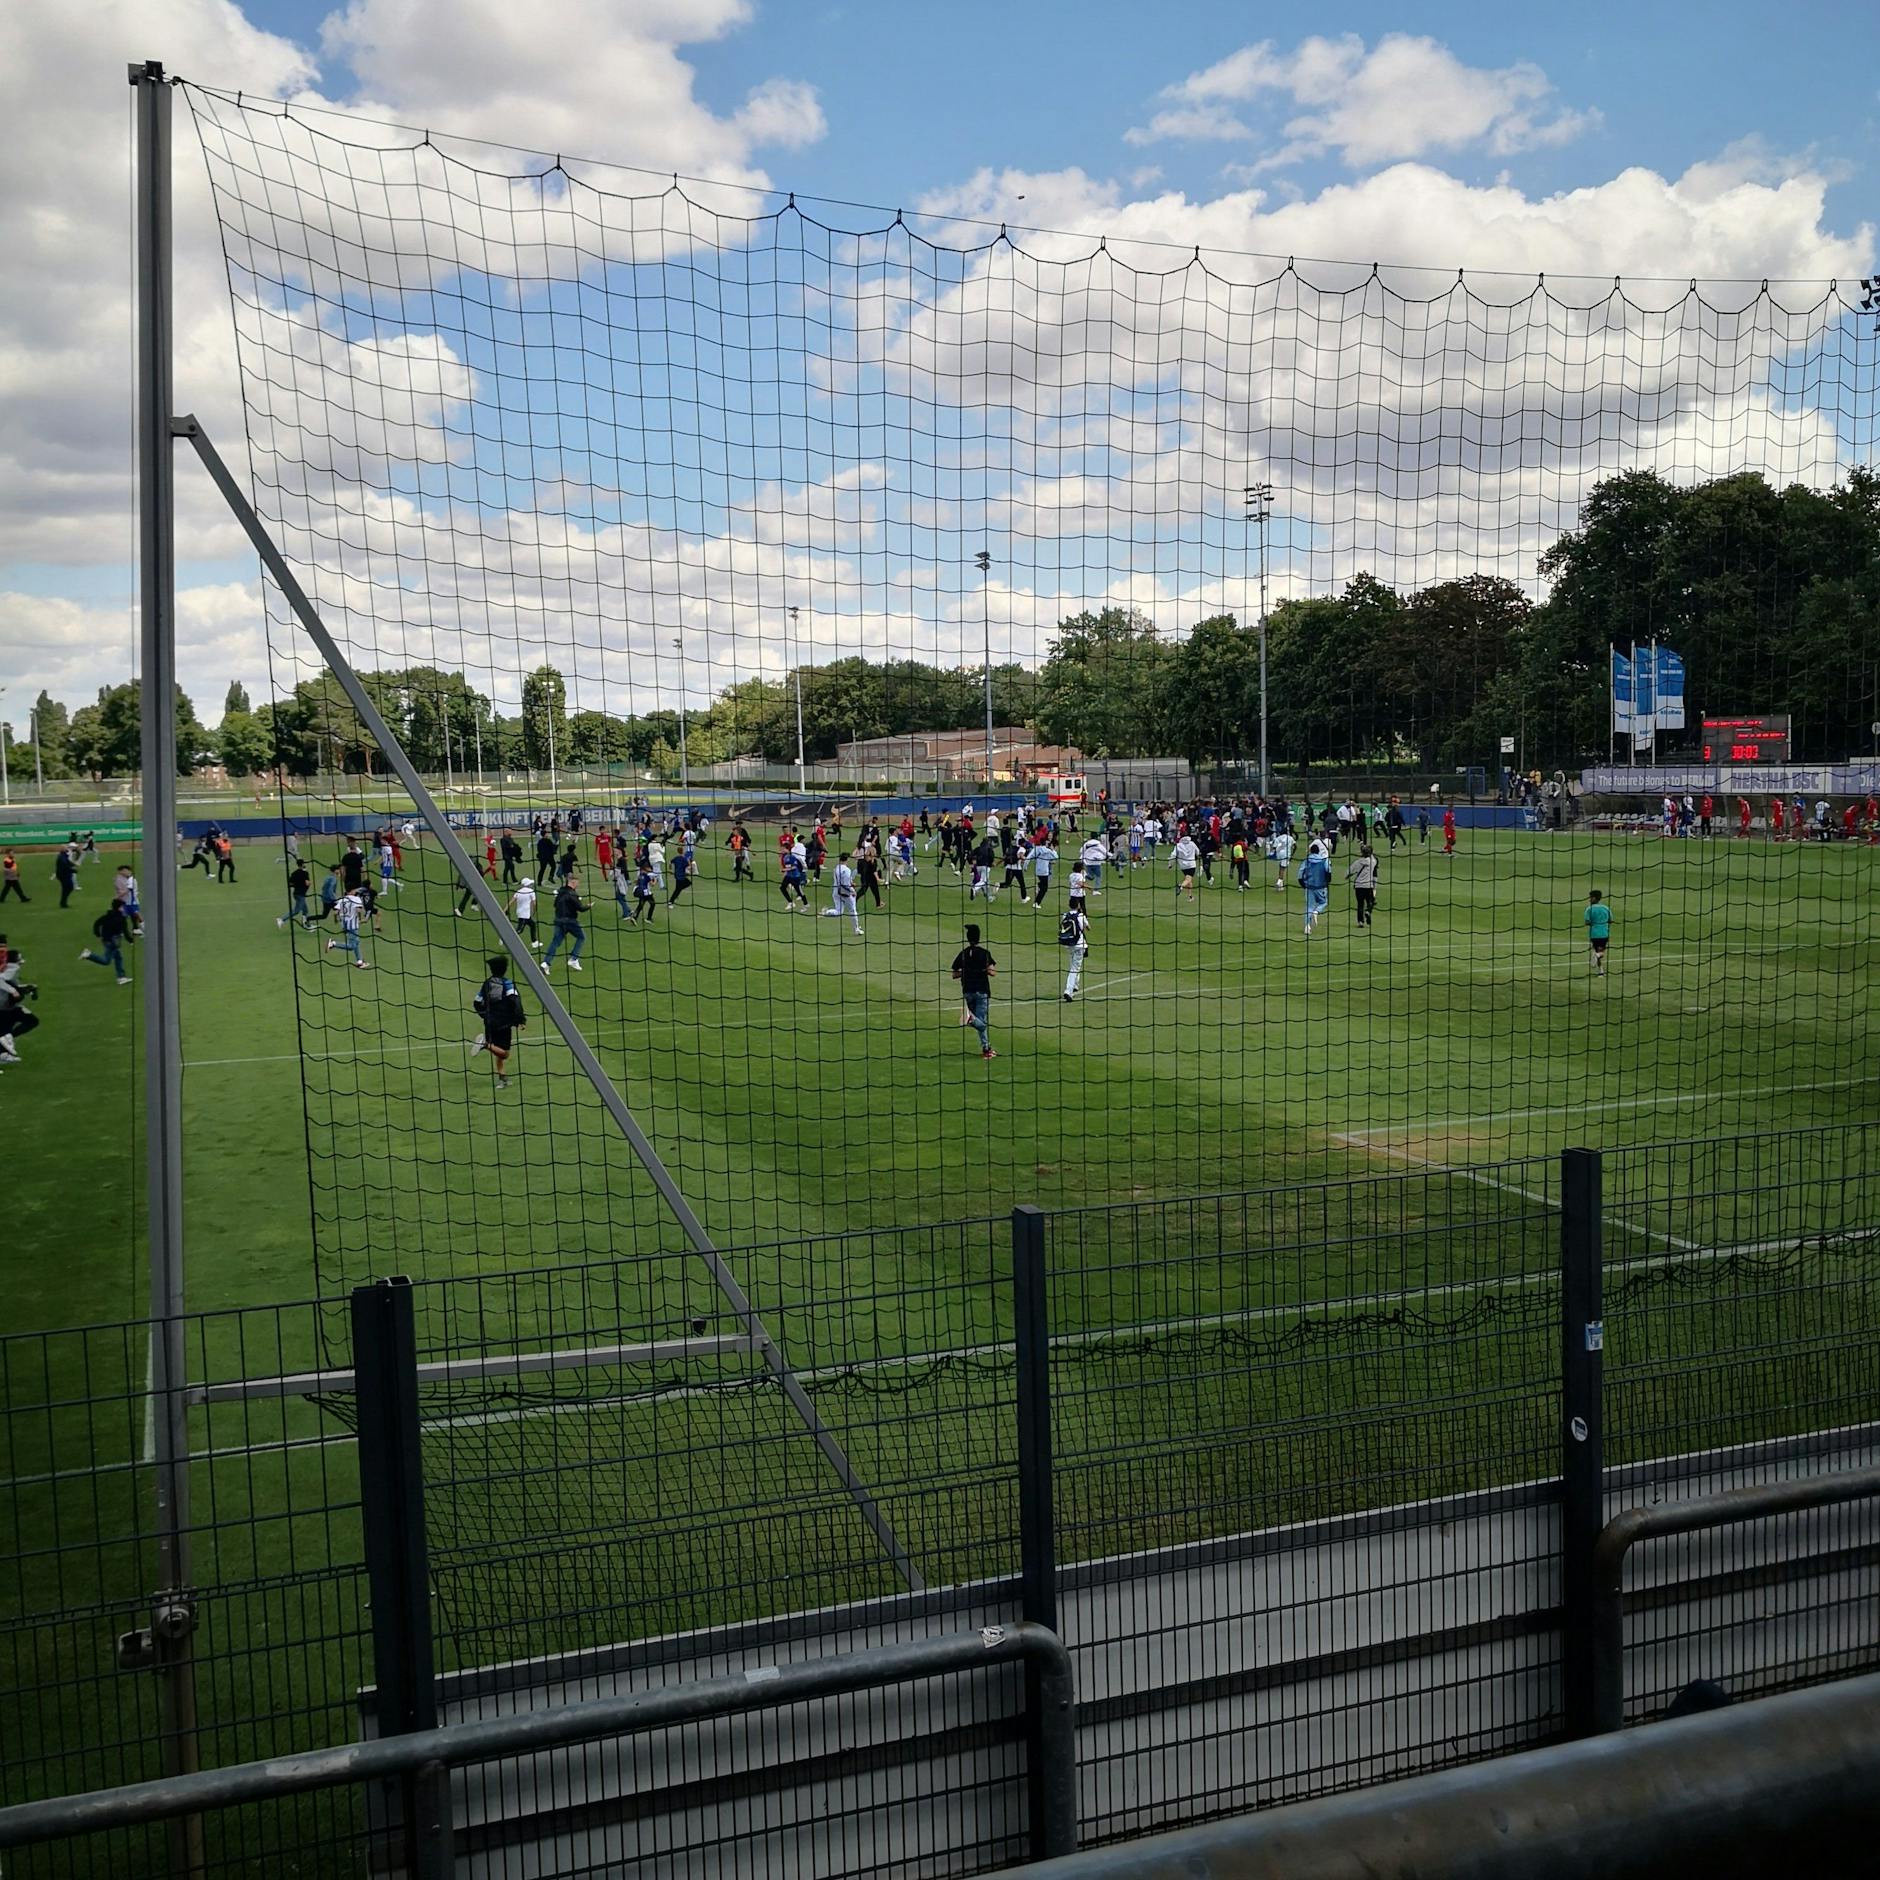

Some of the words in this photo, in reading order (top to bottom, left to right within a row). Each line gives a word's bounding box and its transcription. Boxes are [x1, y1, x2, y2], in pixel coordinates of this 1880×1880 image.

[1599, 775, 1612, 786] The
[1613, 775, 1638, 786] future
[1671, 775, 1681, 786] to
[1682, 774, 1715, 786] BERLIN
[1732, 772, 1789, 790] HERTHA
[1792, 772, 1819, 790] BSC
[448, 813, 471, 827] DIE
[472, 811, 530, 826] ZUKUNFT
